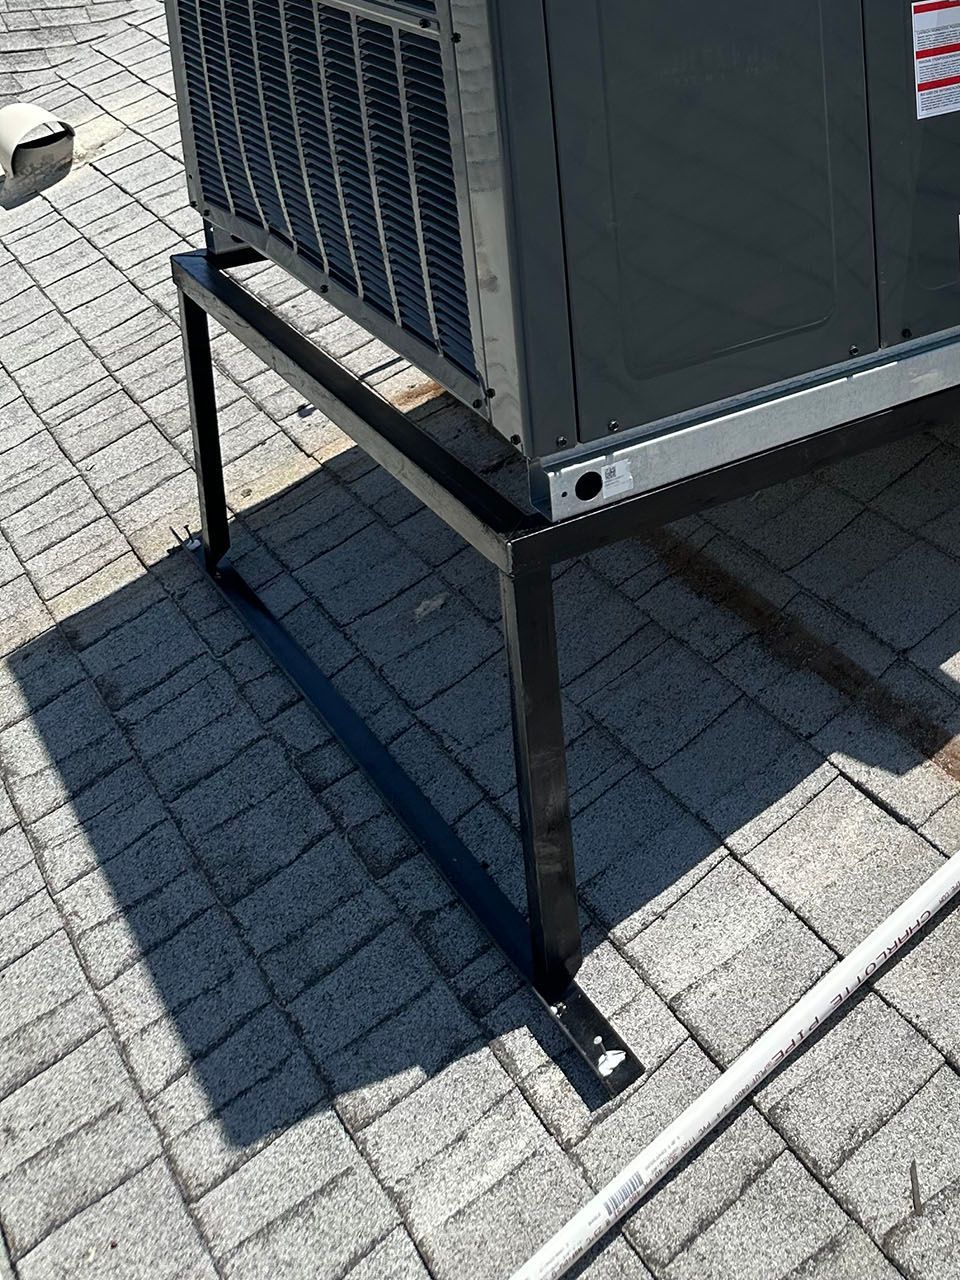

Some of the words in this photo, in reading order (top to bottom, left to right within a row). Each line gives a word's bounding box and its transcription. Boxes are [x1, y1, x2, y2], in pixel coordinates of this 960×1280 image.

[827, 908, 933, 1009] CHARLOTTE
[771, 1015, 821, 1066] PIPE
[696, 1120, 712, 1136] PVC
